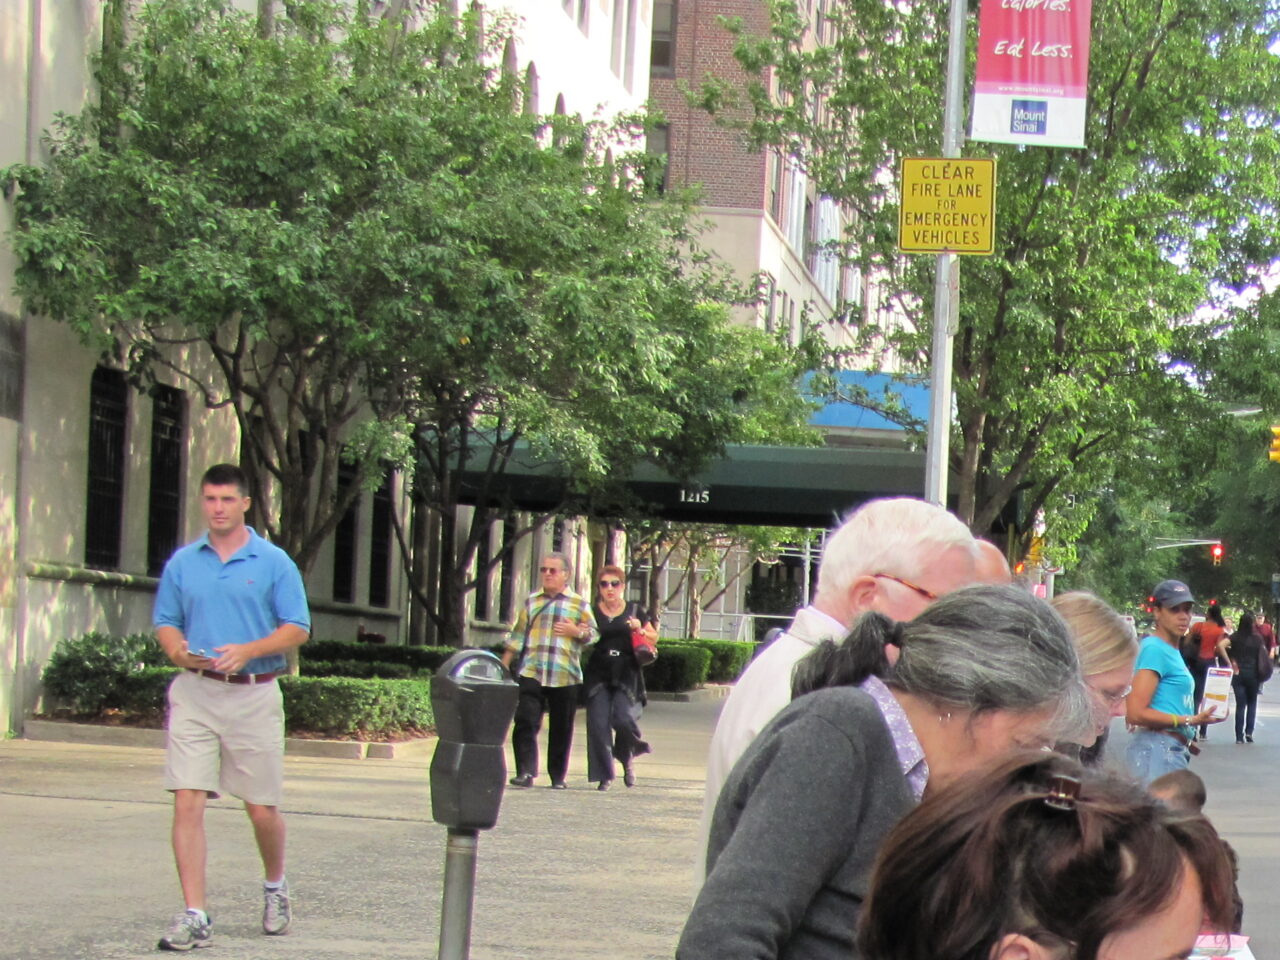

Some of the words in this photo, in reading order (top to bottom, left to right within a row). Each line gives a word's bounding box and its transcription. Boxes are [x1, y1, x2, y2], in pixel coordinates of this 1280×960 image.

[994, 37, 1025, 58] Eat
[1014, 108, 1045, 121] Mount
[1012, 120, 1038, 133] Sinai
[921, 165, 975, 180] CLEAR
[911, 183, 942, 197] FIRE
[948, 183, 983, 198] LANE
[937, 199, 957, 210] FOR
[905, 211, 988, 227] EMERGENCY
[912, 229, 980, 245] VEHICLES
[680, 489, 710, 503] 1215
